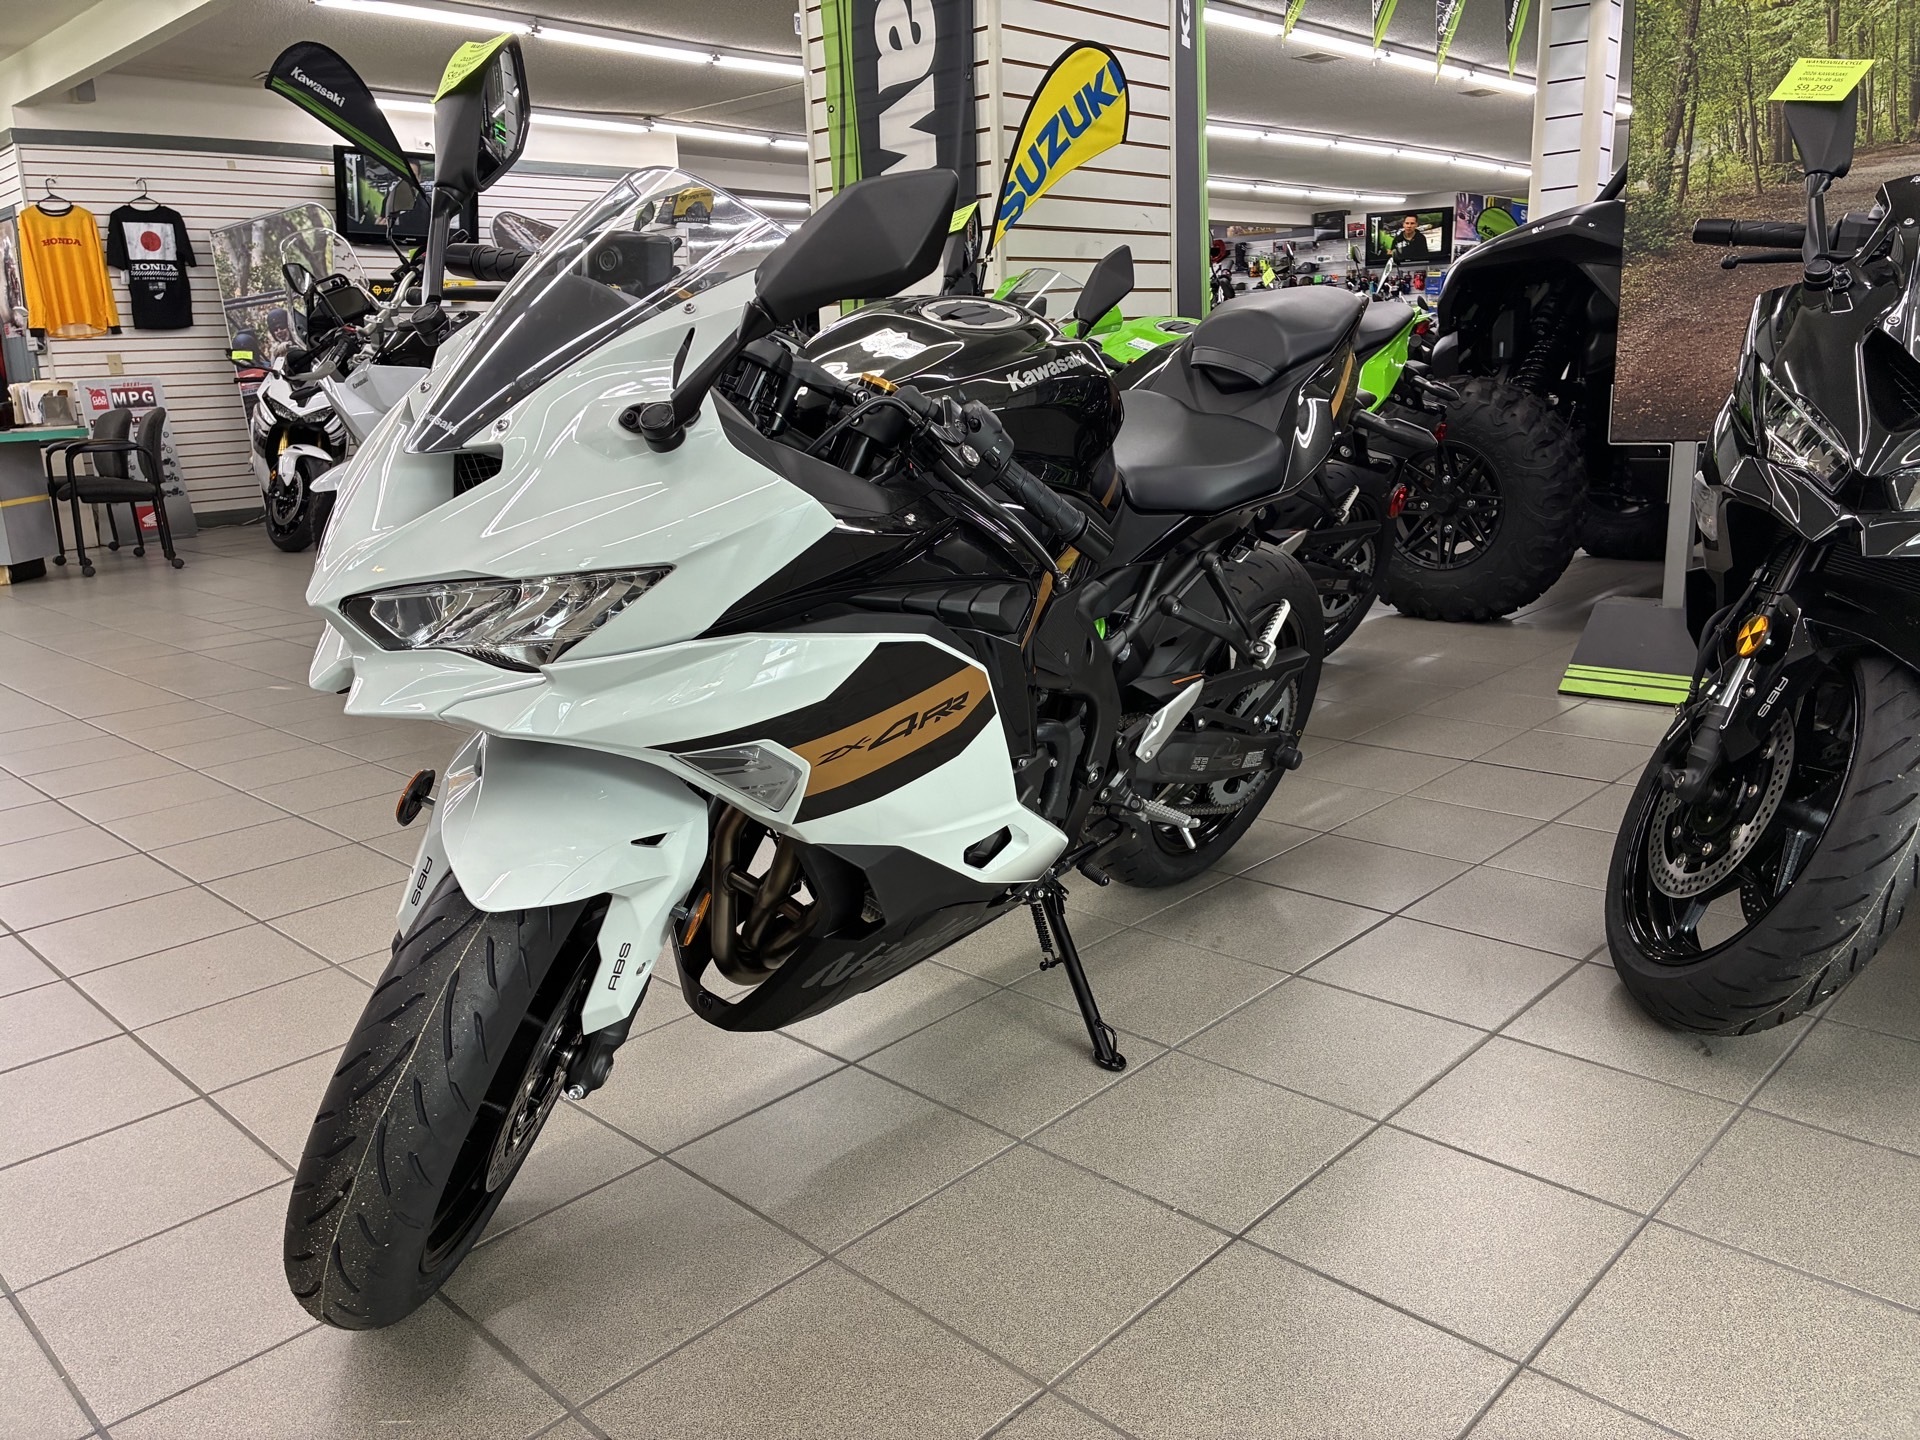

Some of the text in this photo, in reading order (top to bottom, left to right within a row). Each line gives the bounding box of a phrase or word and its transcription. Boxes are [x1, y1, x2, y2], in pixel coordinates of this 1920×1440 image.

[290, 66, 346, 108] Kawasaki
[1794, 83, 1834, 92] $9,299
[999, 59, 1125, 232] SUZUKI
[41, 237, 82, 247] HONDA
[131, 263, 178, 271] HONDA
[1006, 349, 1087, 392] Kawasaki
[1757, 676, 1789, 718] ABS
[411, 856, 433, 907] ABS
[608, 942, 632, 991] ABS
